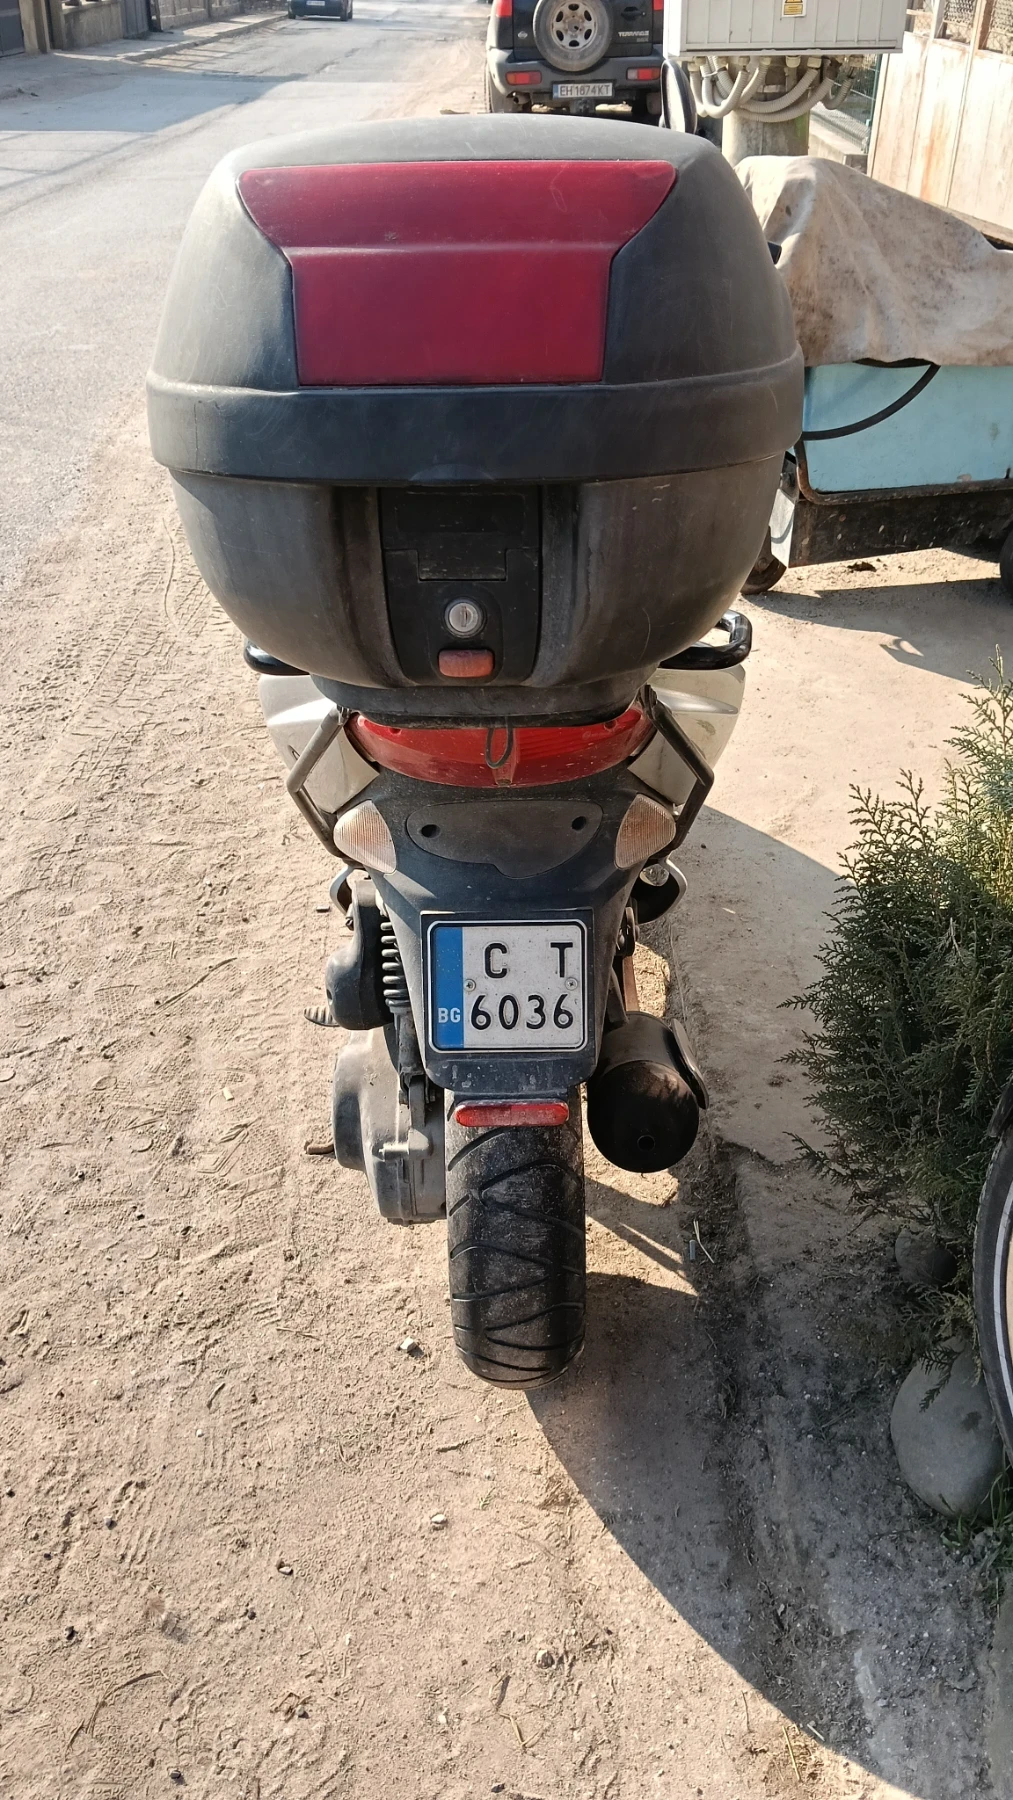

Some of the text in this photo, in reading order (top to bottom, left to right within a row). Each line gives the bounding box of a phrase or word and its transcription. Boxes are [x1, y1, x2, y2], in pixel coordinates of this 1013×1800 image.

[484, 942, 574, 979] C T
[438, 1008, 461, 1023] BG
[470, 994, 574, 1030] 6036
